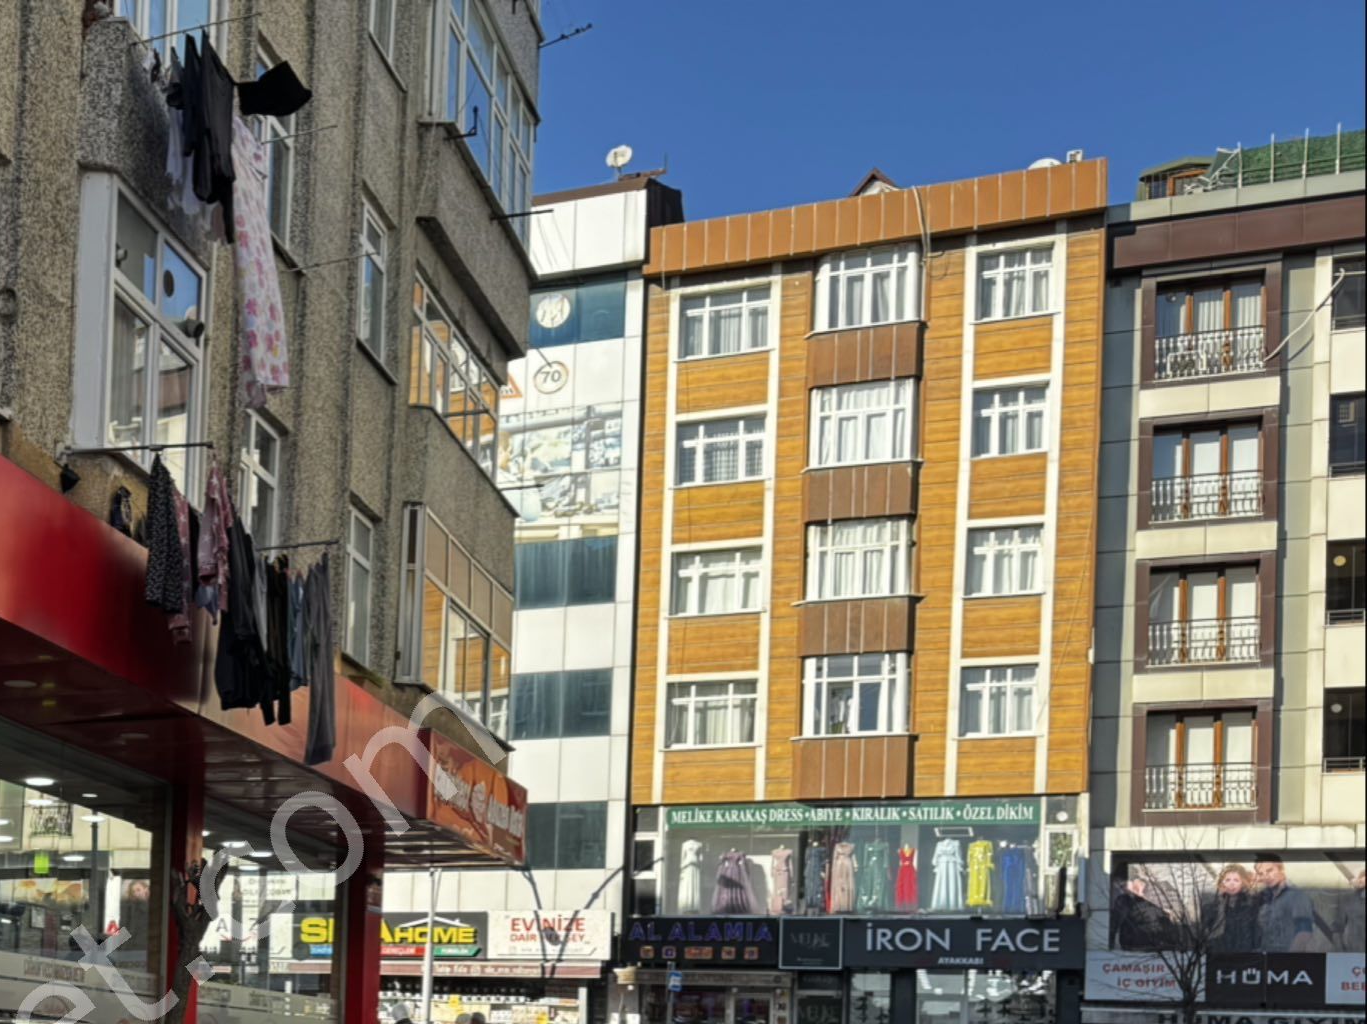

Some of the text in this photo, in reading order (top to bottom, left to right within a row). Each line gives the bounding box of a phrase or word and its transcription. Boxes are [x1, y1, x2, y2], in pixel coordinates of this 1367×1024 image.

[671, 809, 713, 824] MELİKE
[715, 808, 767, 825] KARAKAŞ
[769, 808, 803, 822] DRESS
[852, 807, 900, 821] KIRALIK
[908, 806, 954, 820] SATILIK
[963, 804, 994, 820] ÖZEL
[997, 803, 1034, 820] DİKİM
[628, 921, 662, 941] AL
[976, 928, 1060, 952] FACE
